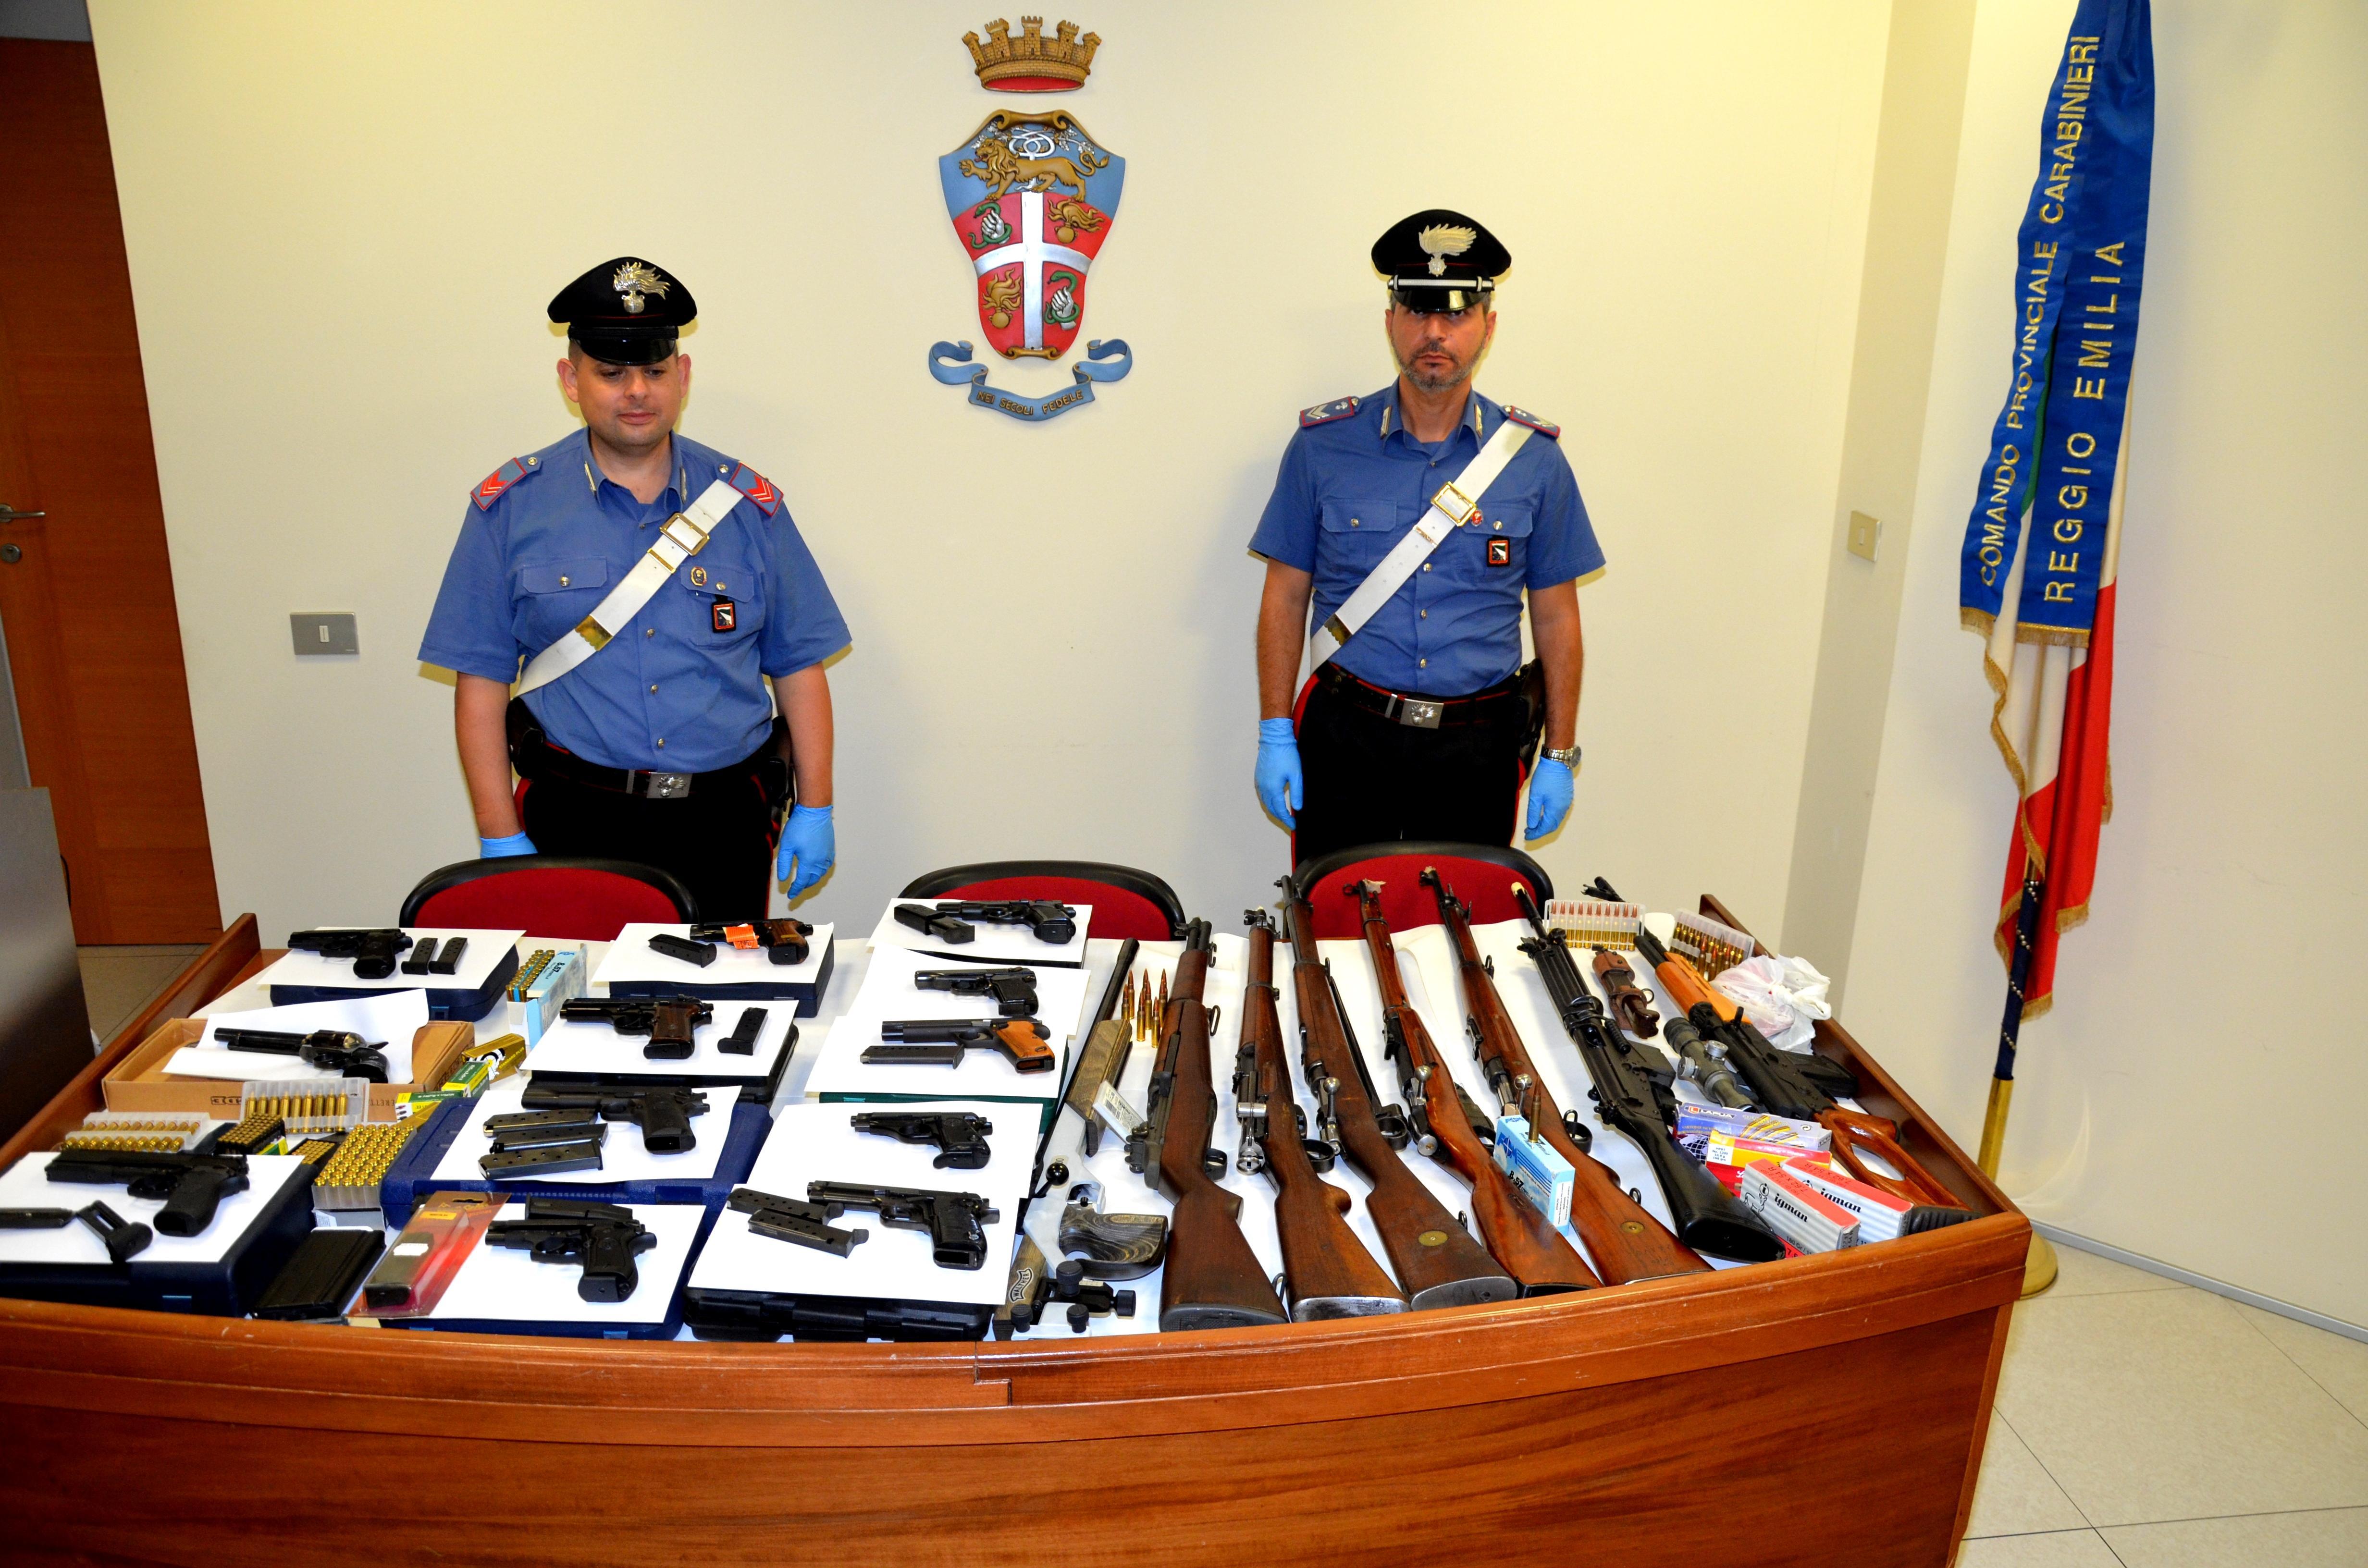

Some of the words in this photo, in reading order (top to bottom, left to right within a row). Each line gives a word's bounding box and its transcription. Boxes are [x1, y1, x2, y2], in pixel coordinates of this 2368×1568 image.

[1979, 443, 2020, 586] COMANDO
[2007, 241, 2058, 429] PROVINCIALE
[2039, 37, 2100, 224] CARABINIERI
[977, 391, 995, 403] NEI
[999, 398, 1033, 416] SECOLI
[1042, 390, 1084, 414] FEDELE
[2044, 432, 2096, 603] REGGIO
[2074, 242, 2125, 399] EMILIA
[499, 1054, 516, 1069] STANDARD
[1701, 1109, 1733, 1118] LAPUA
[1774, 1193, 1808, 1223] igman
[1012, 1273, 1029, 1297] WALTHER
